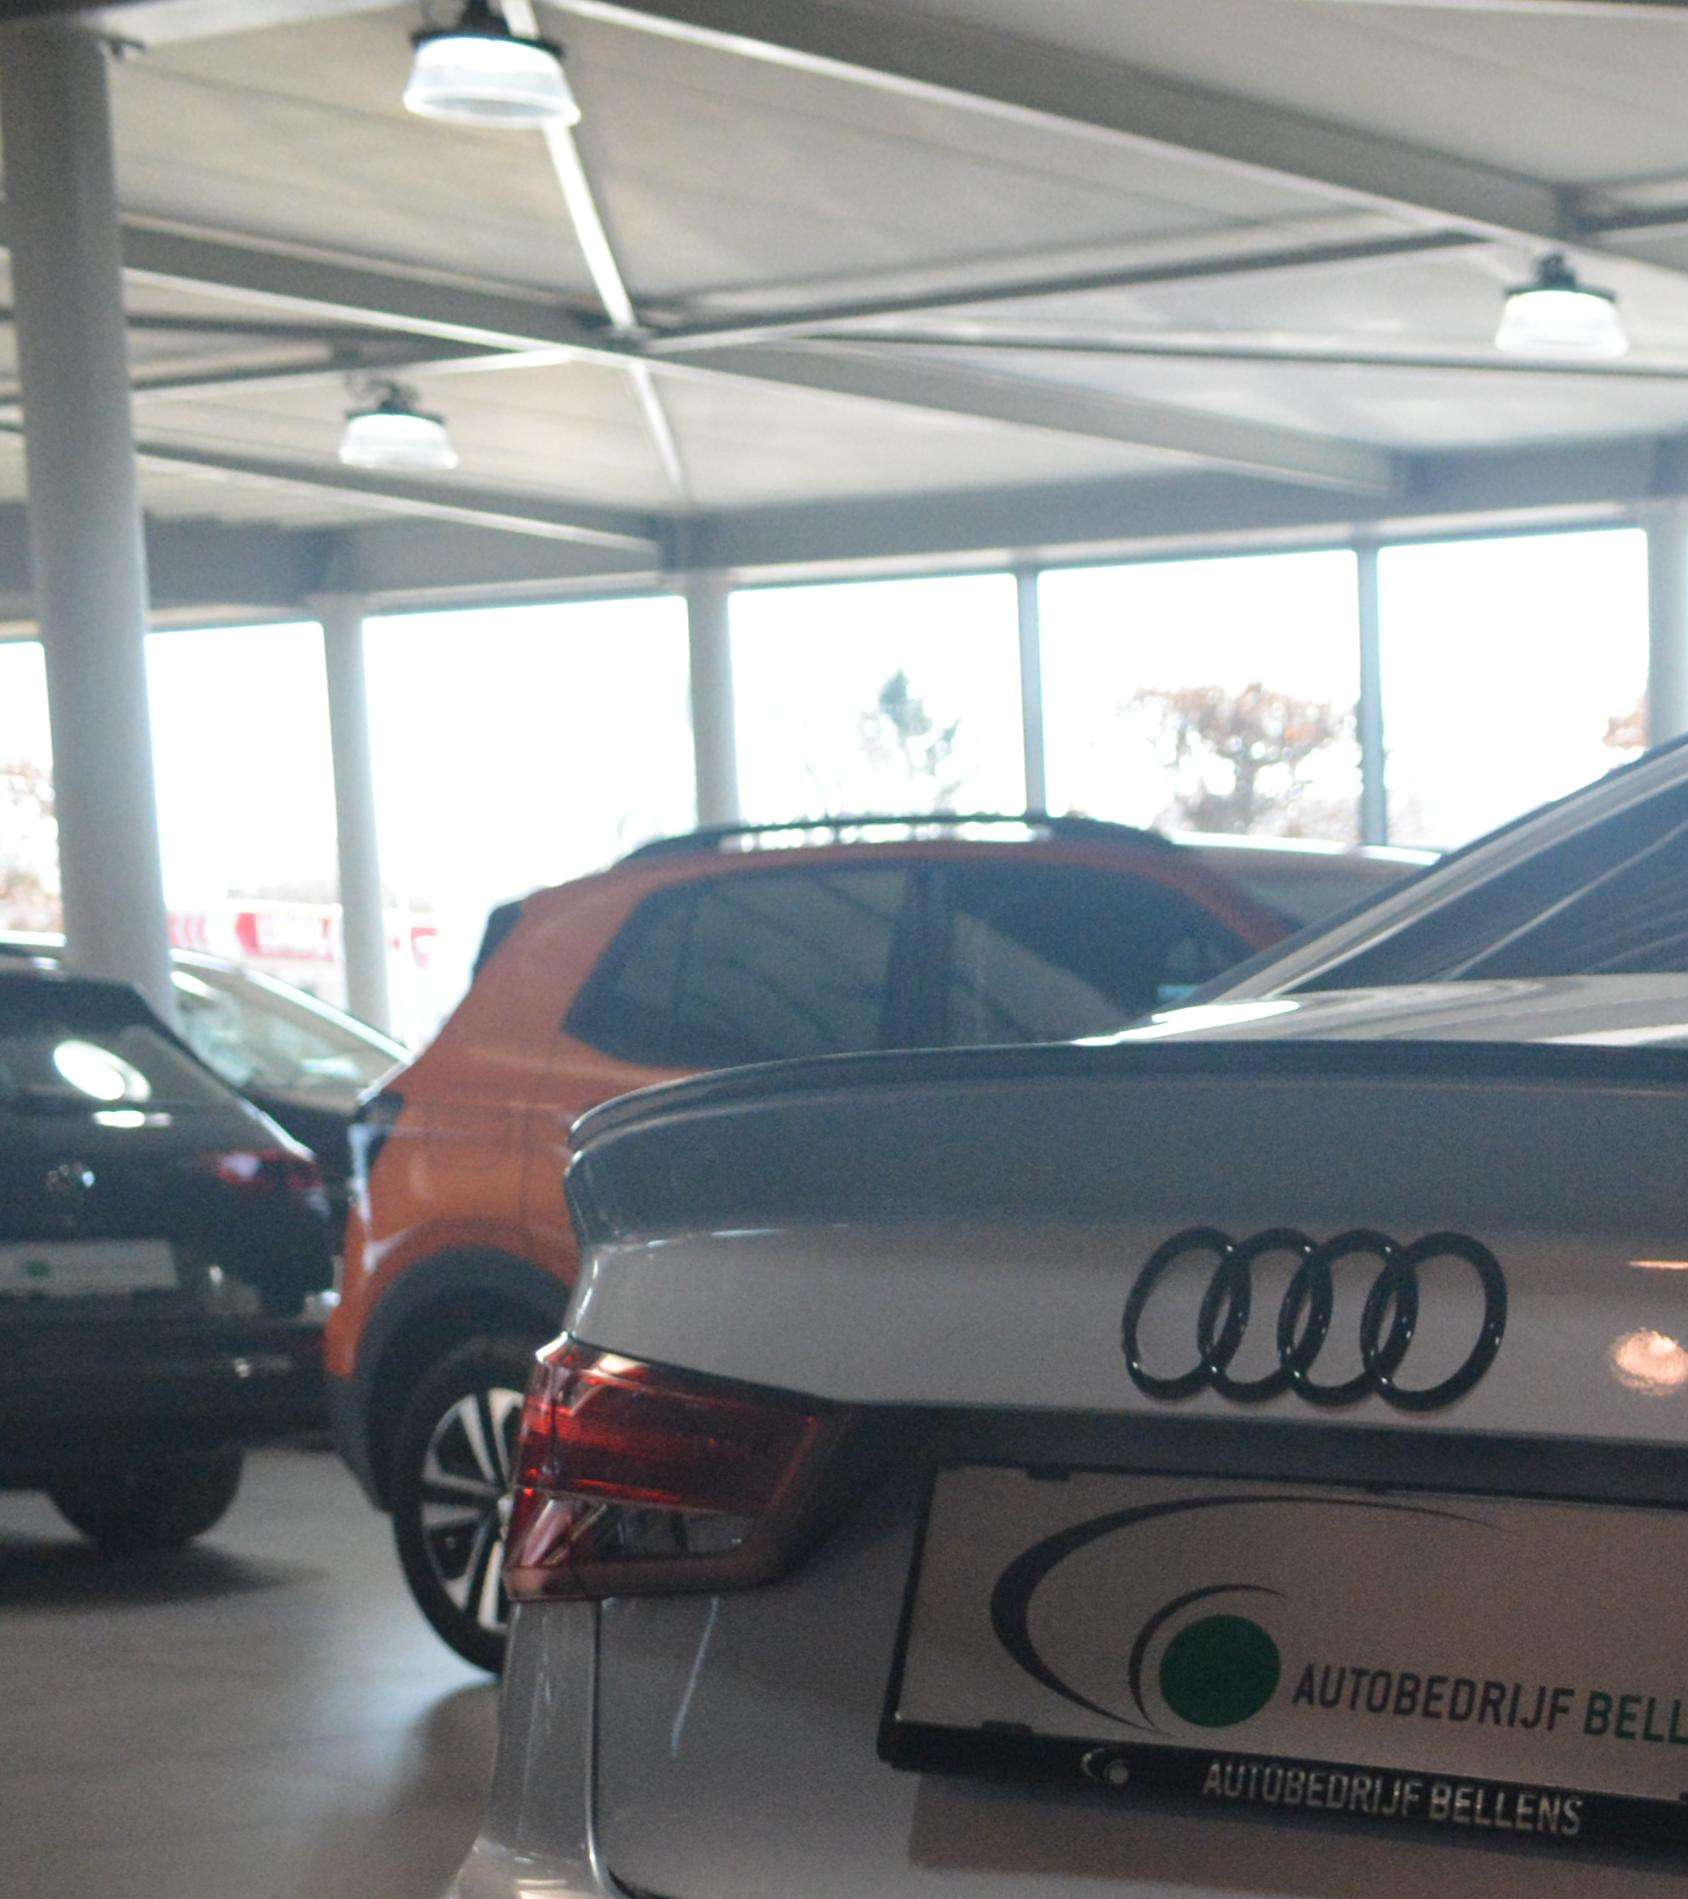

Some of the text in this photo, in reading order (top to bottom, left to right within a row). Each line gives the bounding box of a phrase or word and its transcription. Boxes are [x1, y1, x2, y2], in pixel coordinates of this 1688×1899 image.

[1291, 1662, 1576, 1732] AUTOBEDRIJF
[1202, 1761, 1583, 1836] AUTOBEDRIJF BELLENS
